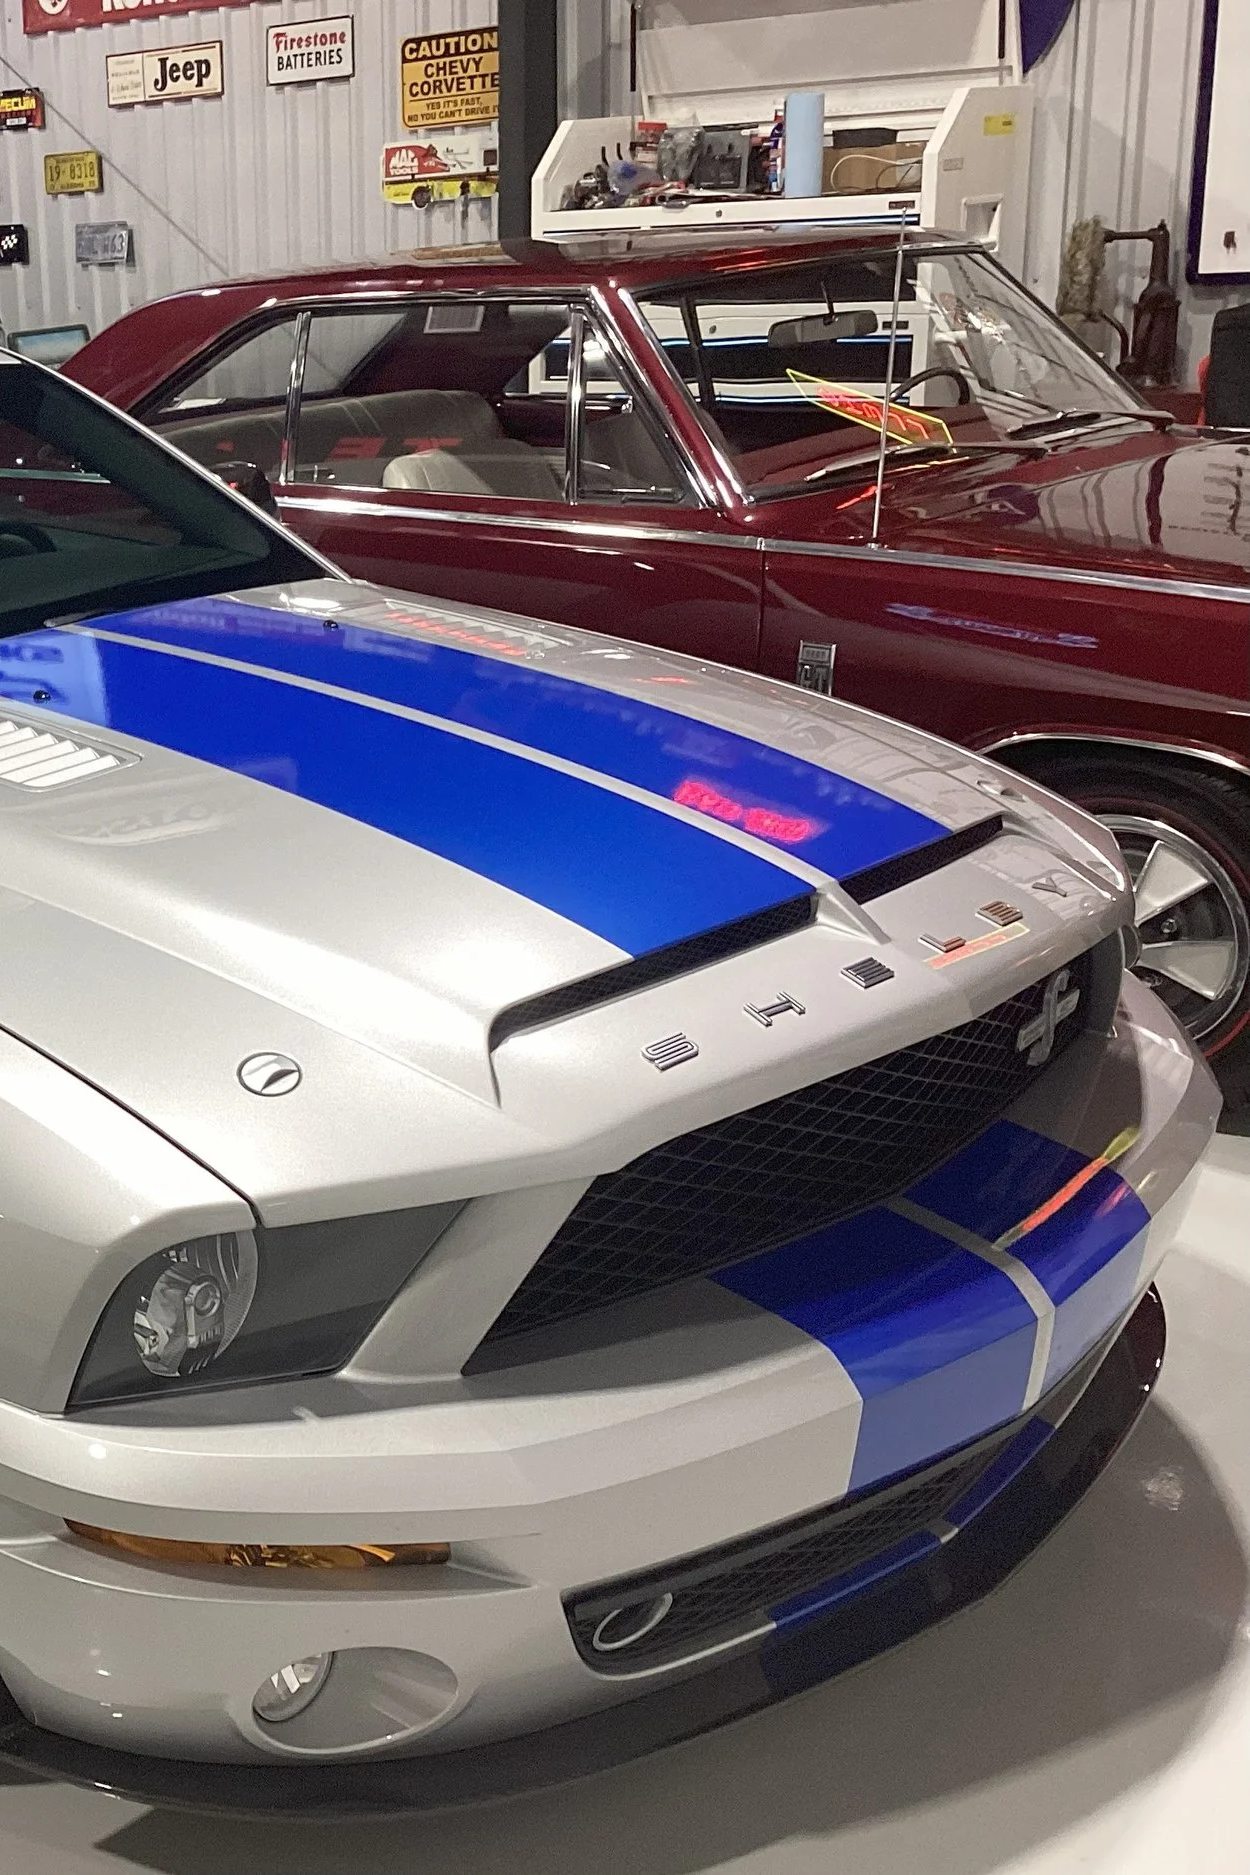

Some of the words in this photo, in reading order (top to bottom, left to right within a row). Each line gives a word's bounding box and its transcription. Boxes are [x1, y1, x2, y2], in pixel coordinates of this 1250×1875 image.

[273, 31, 346, 53] Firestone
[404, 31, 498, 60] CAUTION
[277, 48, 343, 71] BATTERIES
[424, 56, 483, 78] CHEVY
[154, 57, 211, 91] Jeep
[409, 72, 499, 97] CORVETTE
[407, 114, 419, 122] NO
[421, 112, 437, 121] YOU
[439, 109, 462, 119] CAN'T
[465, 106, 489, 116] DRIVE
[426, 101, 441, 110] YES
[443, 99, 459, 108] IT'S
[390, 149, 418, 168] MAC
